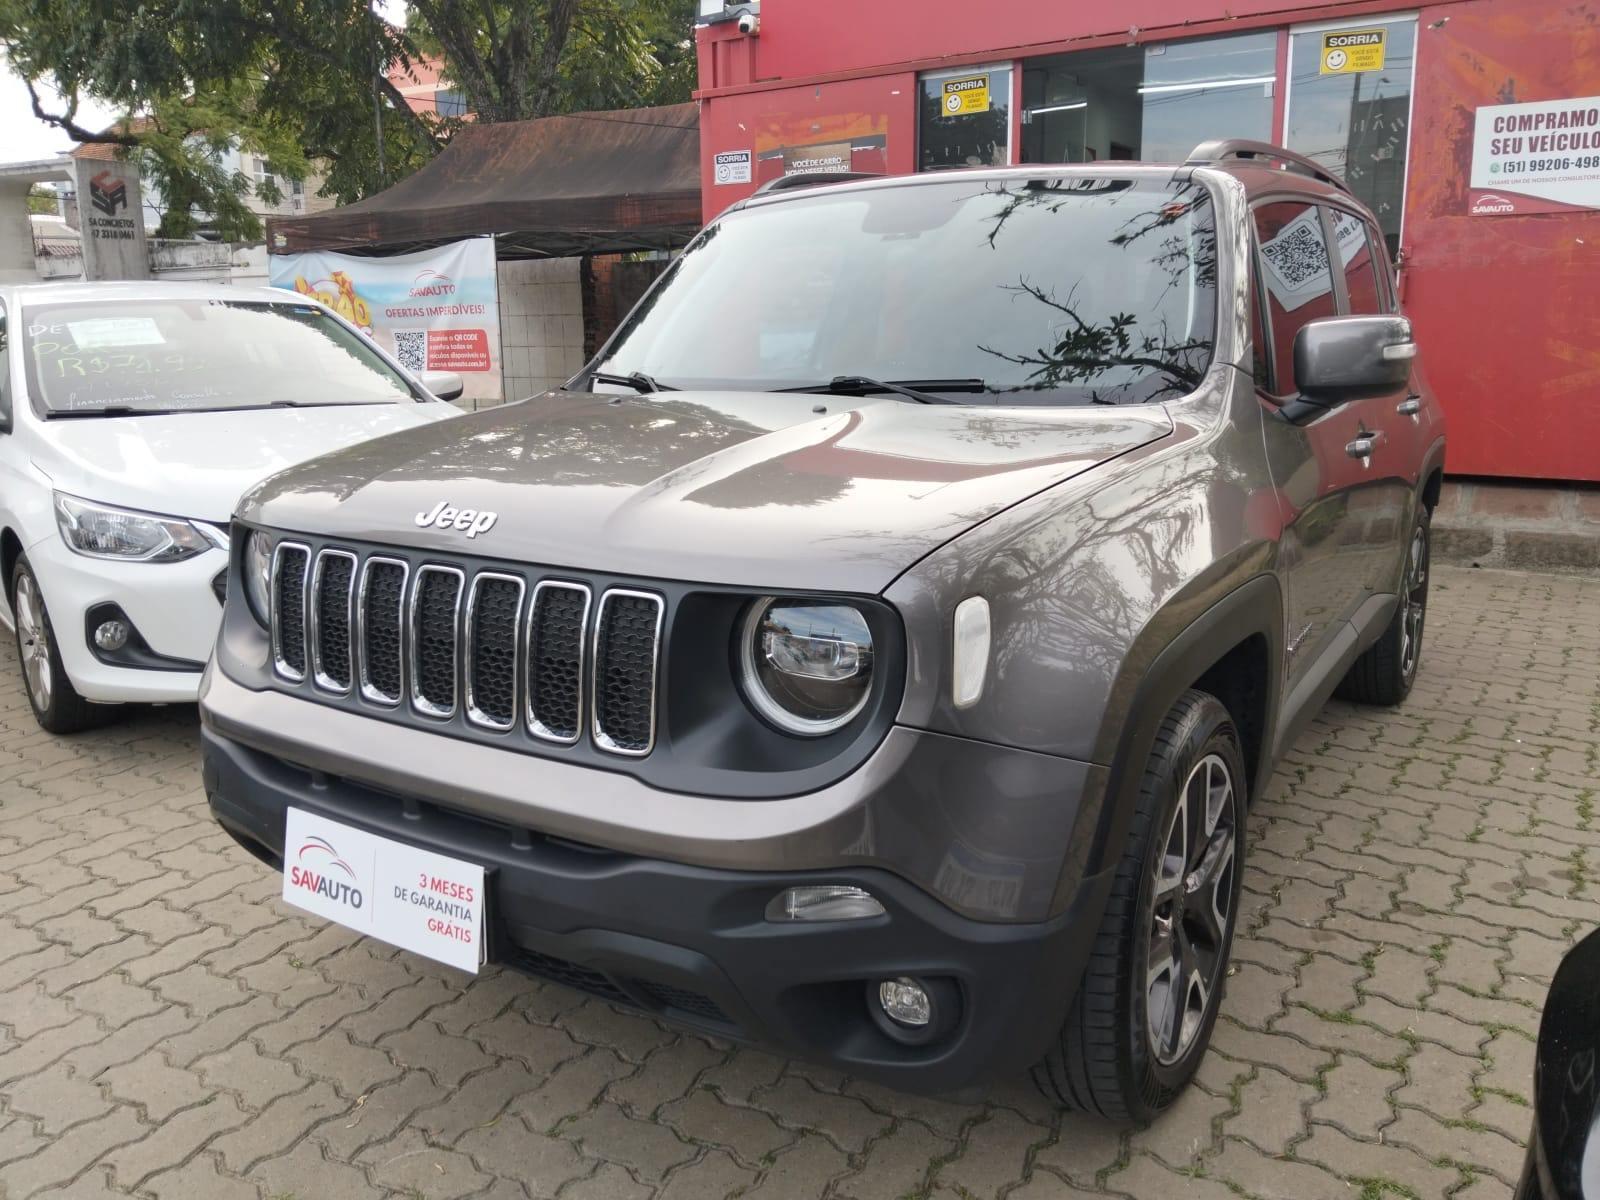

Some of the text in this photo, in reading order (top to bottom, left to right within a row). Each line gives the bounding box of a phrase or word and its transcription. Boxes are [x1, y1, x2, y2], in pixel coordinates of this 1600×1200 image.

[1328, 34, 1379, 47] SORRIA
[946, 79, 984, 92] SORRIA
[1493, 108, 1600, 133] COMPRAMO
[1491, 137, 1523, 155] SEU
[717, 153, 748, 163] SORRIA
[792, 156, 842, 168] VOCÊ DE CARRO
[1503, 161, 1526, 173] (51)
[1472, 204, 1514, 213] SAVAUTO
[409, 284, 456, 297] SAVAUTO
[385, 303, 486, 319] OFERTAS IMPERDÍVEIS!
[29, 325, 62, 336] DE
[454, 333, 462, 341] QR
[463, 333, 477, 341] CODE
[415, 501, 498, 539] Jeep
[291, 866, 363, 909] SAVAUTO
[419, 873, 473, 902] 3 MESES
[394, 885, 473, 922] DE GARANTIA
[427, 917, 472, 943] GRÁTIS
